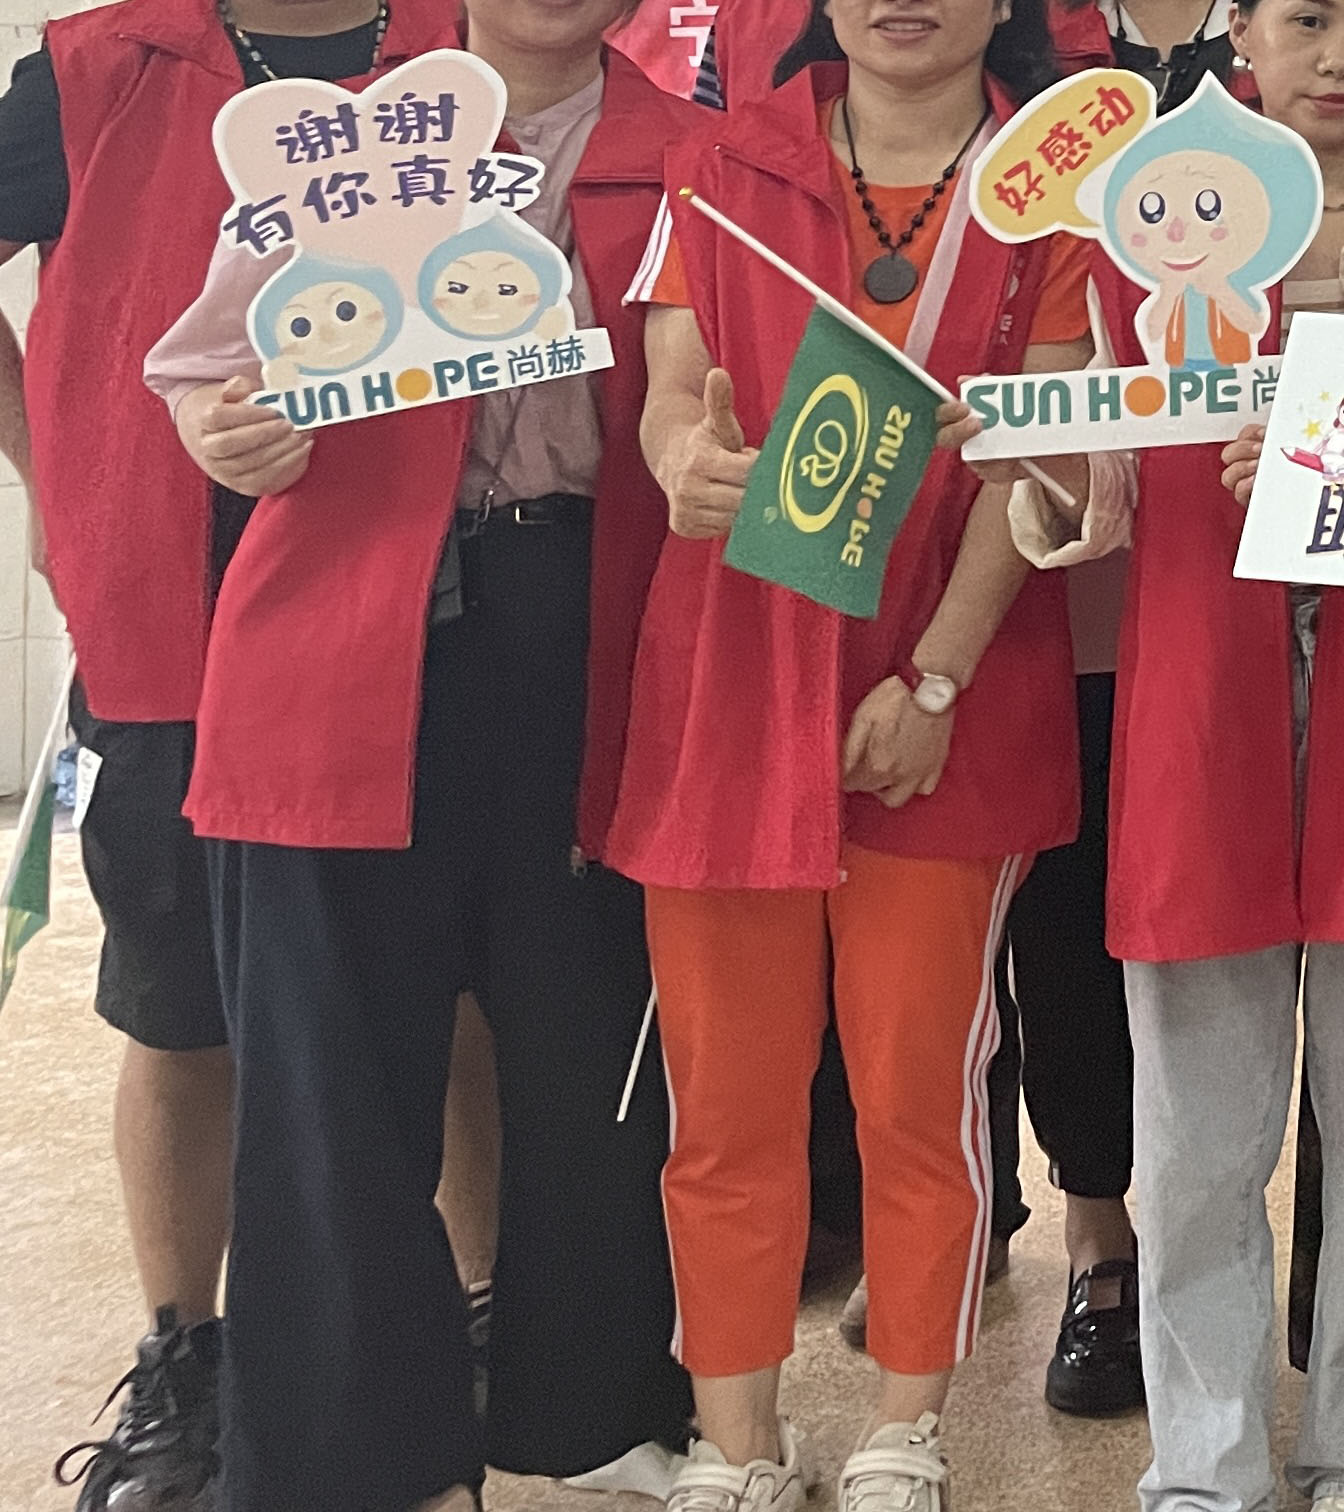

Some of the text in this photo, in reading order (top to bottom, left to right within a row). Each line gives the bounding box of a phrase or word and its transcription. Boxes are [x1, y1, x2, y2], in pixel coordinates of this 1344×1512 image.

[275, 91, 460, 165] 谢谢
[992, 84, 1137, 217] 好感动
[222, 155, 540, 255] 有你真好
[361, 351, 500, 414] HOPE
[507, 335, 586, 382] 尚赫
[965, 378, 1073, 430] SUN
[1088, 367, 1240, 422] HOPE
